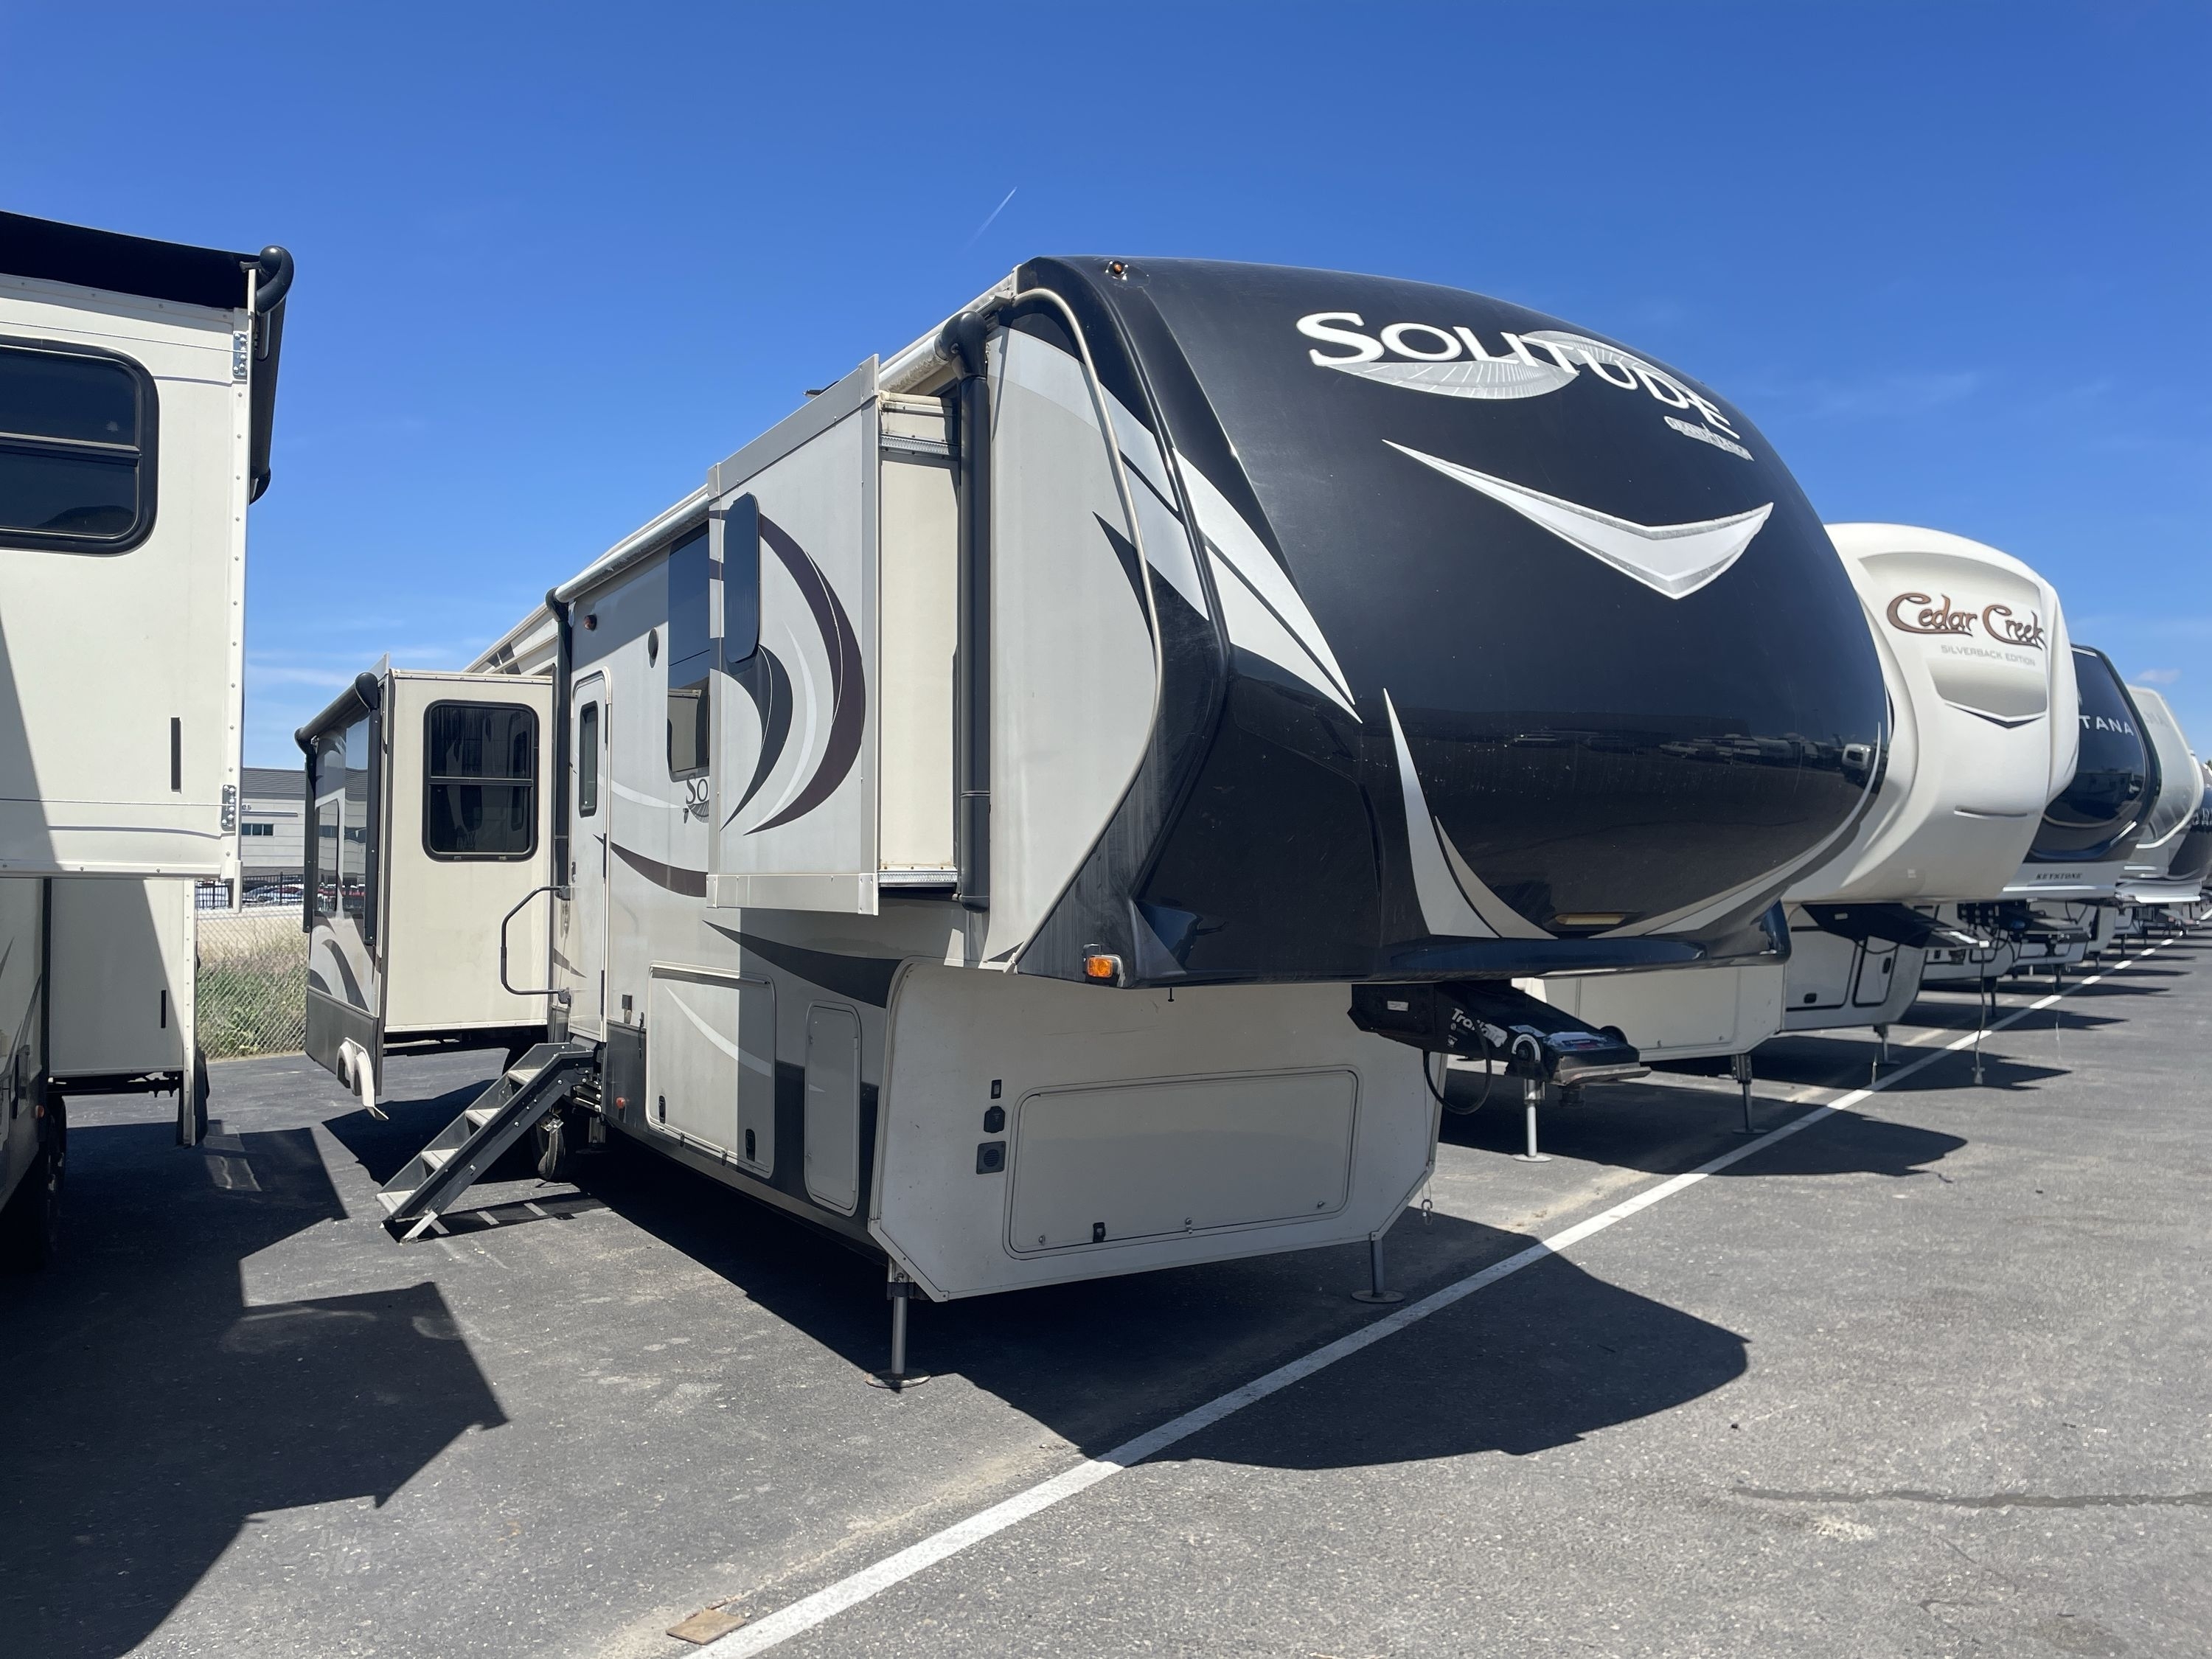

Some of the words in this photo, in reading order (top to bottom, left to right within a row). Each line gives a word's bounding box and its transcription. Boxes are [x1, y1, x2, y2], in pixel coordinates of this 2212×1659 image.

[1295, 311, 1741, 439] SOLITUDE
[1887, 593, 1978, 637] Cedar
[1983, 605, 2048, 650] Creek
[1940, 644, 2003, 659] SILVERBACK
[2005, 653, 2035, 666] EDITION
[2079, 714, 2135, 737] TANA
